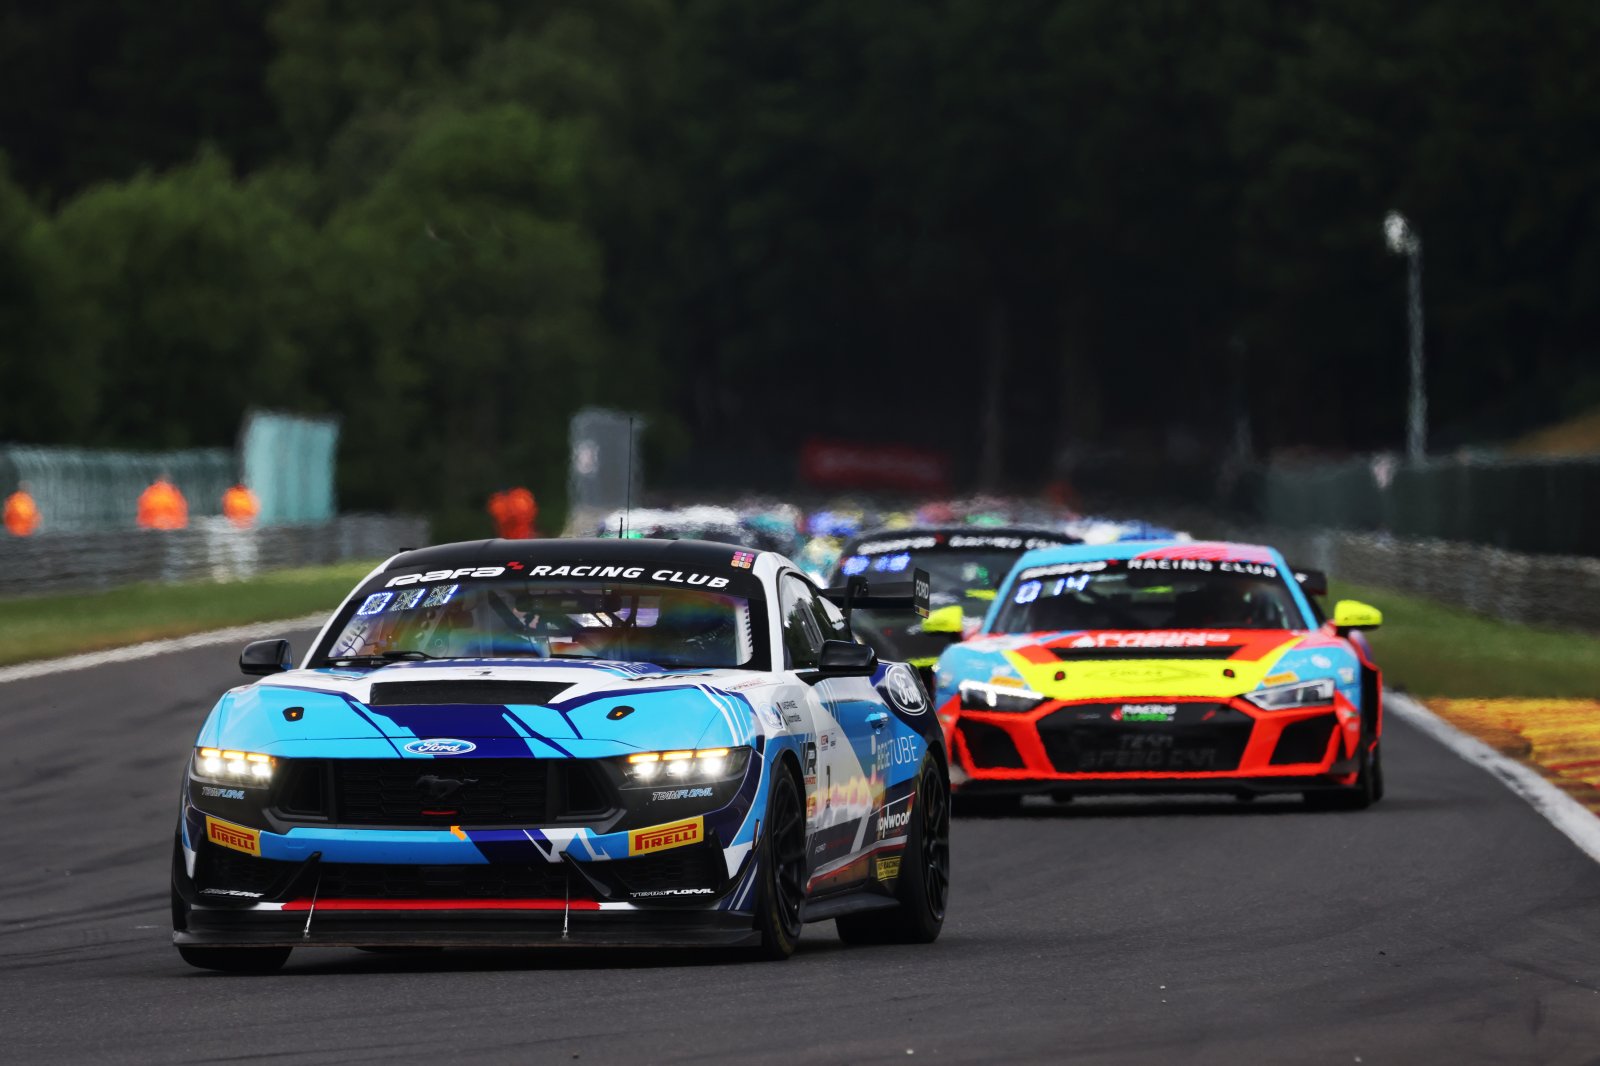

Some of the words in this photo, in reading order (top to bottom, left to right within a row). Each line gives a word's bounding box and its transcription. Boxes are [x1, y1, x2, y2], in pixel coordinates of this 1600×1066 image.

[529, 565, 645, 579] RACING
[651, 569, 730, 588] CLUB
[916, 579, 929, 600] FORD
[210, 822, 256, 851] PIRELLI
[634, 823, 698, 851] PIRELLI
